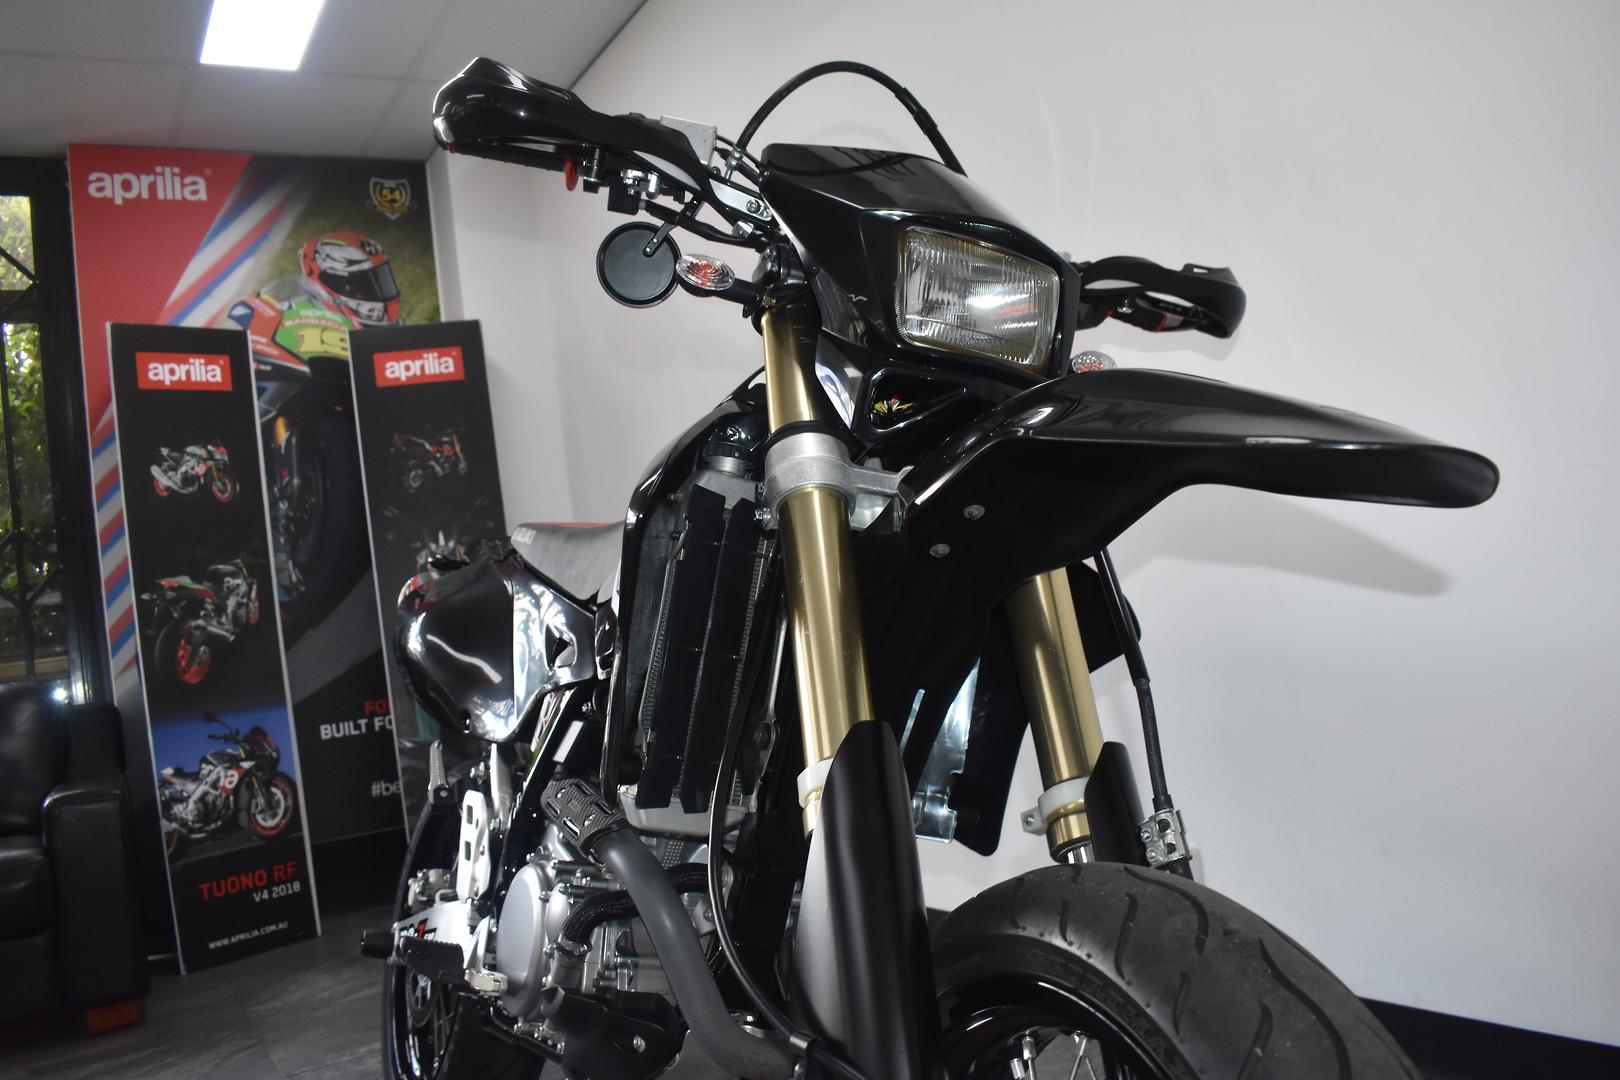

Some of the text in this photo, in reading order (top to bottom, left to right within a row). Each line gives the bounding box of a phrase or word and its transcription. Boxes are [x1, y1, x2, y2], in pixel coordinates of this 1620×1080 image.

[88, 166, 208, 206] aprilia
[148, 358, 222, 386] aprilia
[384, 352, 455, 382] aprilia
[319, 718, 369, 740] BUILT
[199, 860, 297, 902] TUONO RF
[253, 881, 301, 903] V4 2018
